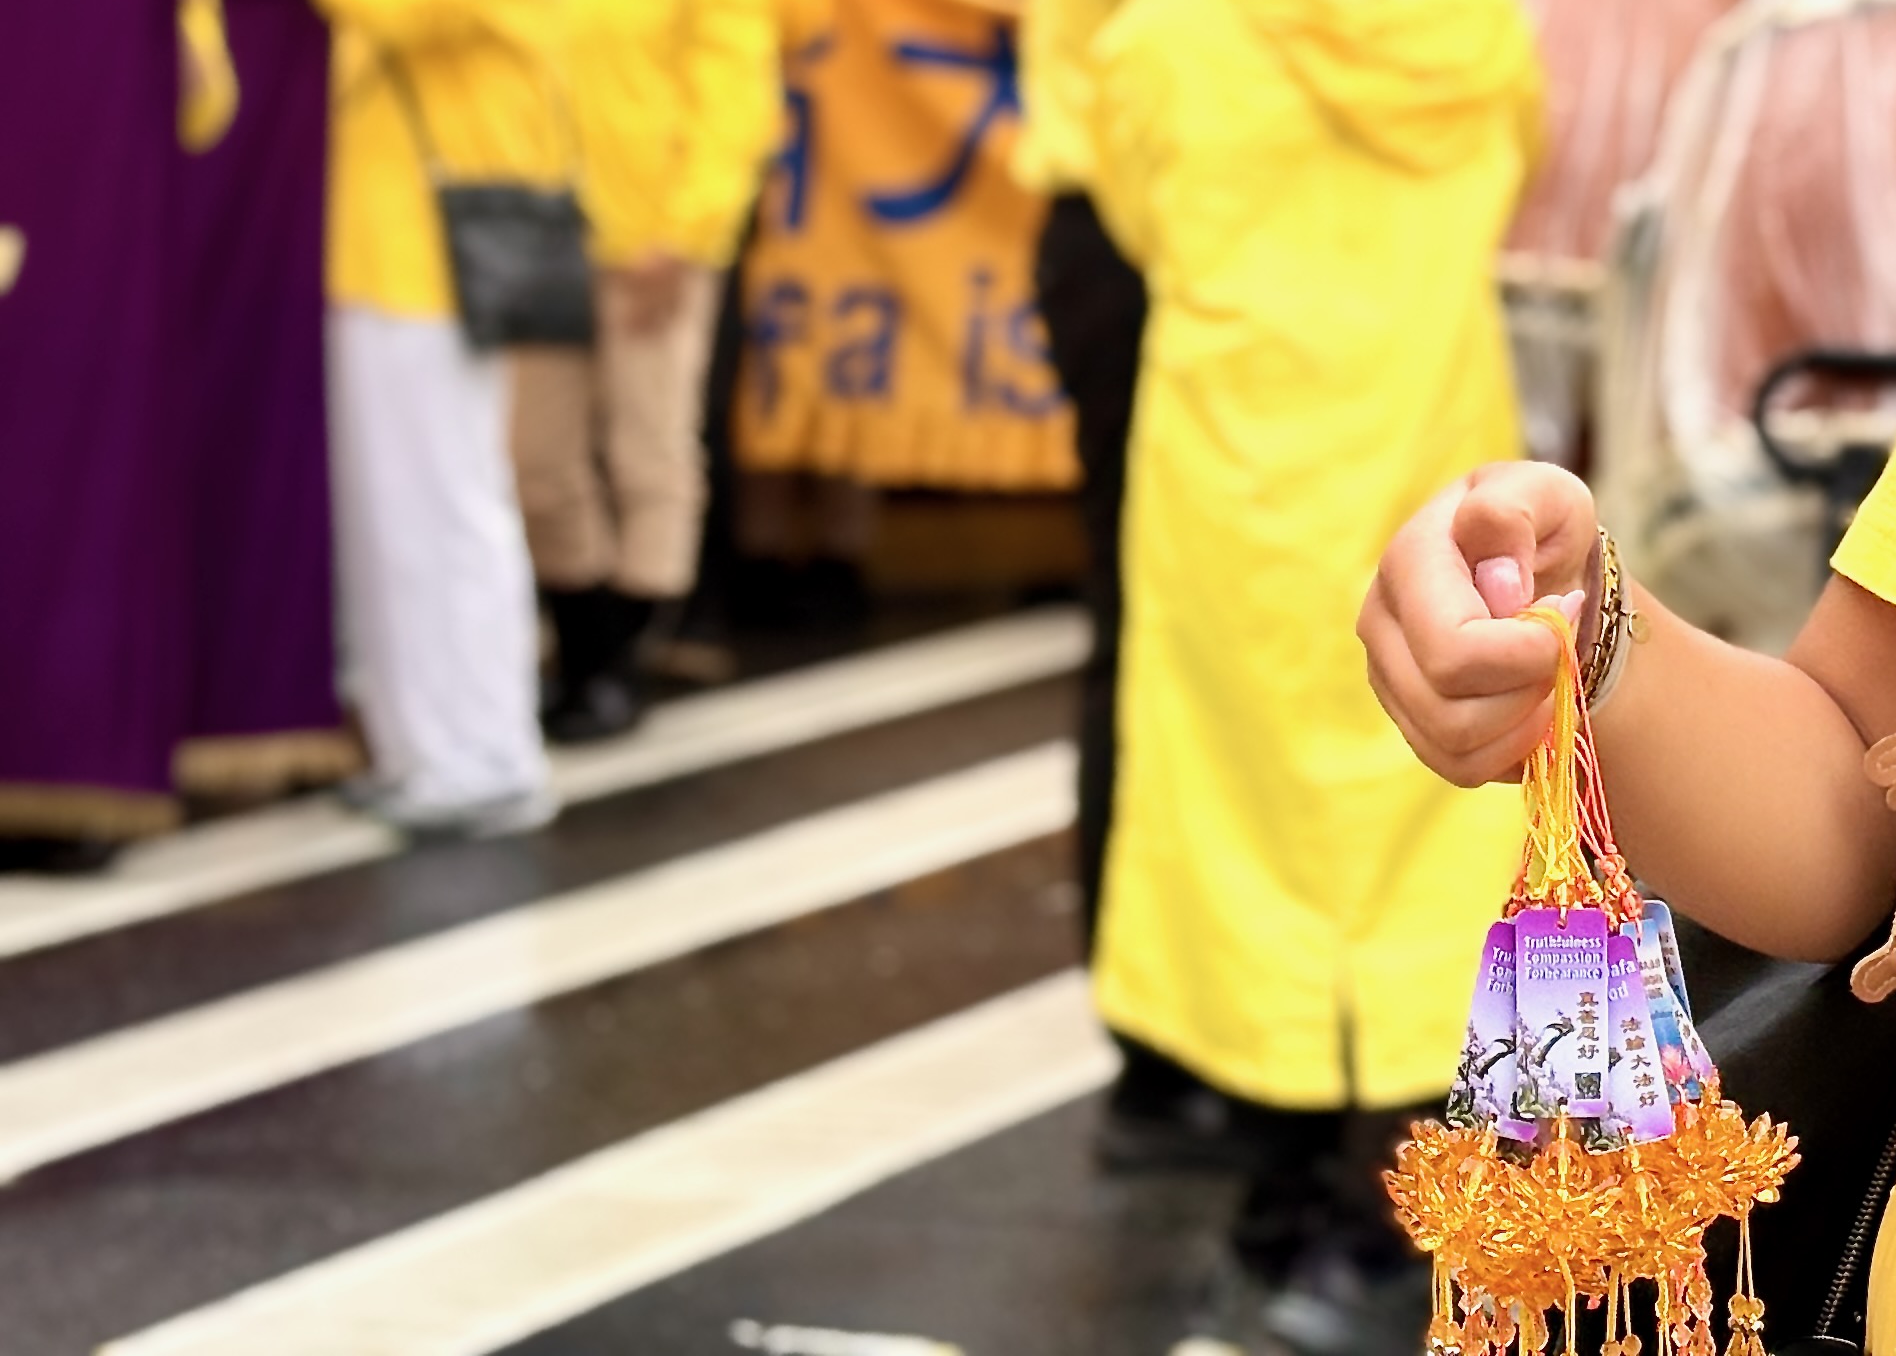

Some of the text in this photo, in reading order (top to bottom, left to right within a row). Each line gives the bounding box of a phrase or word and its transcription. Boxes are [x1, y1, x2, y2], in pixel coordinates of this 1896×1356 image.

[1524, 935, 1602, 950] Truthfulness
[1524, 951, 1602, 966] Compassion
[1525, 967, 1602, 980] Forbearance
